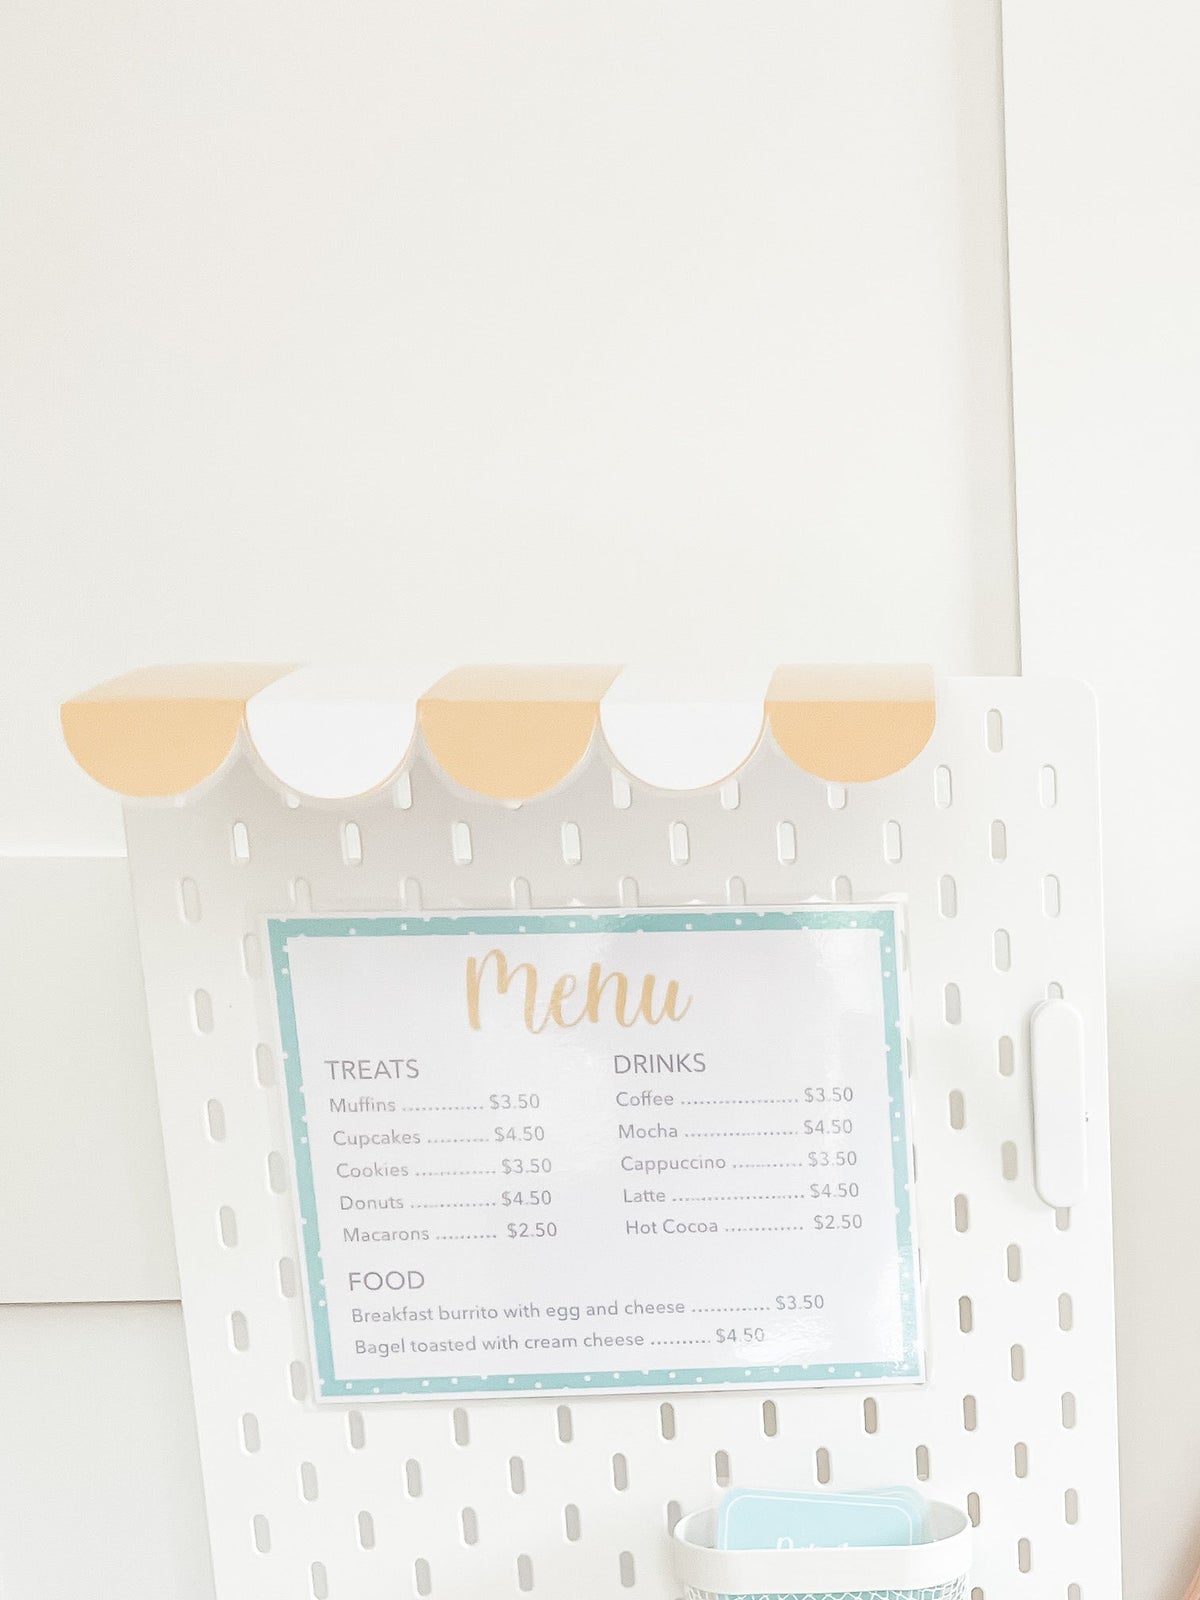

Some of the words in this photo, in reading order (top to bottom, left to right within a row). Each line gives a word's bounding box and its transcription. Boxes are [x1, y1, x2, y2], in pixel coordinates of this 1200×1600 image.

[465, 948, 693, 1034] Menu
[324, 1059, 420, 1080] TREATS
[614, 1053, 707, 1075] DRINKS
[329, 1096, 396, 1113] Muffins
[489, 1094, 540, 1110] $3.50
[616, 1090, 674, 1107] Coffee
[804, 1087, 853, 1103] $3.50
[333, 1129, 421, 1149] Cupcakes
[494, 1126, 545, 1142] $4.50
[618, 1123, 678, 1139] Mocha
[804, 1119, 853, 1135] $4.50
[336, 1162, 409, 1178] Cookies
[501, 1158, 552, 1175] $3.50
[621, 1155, 726, 1174] Cappuccino
[808, 1151, 857, 1167] $3.50
[340, 1195, 404, 1211] Donuts
[501, 1190, 552, 1207] $4.50
[623, 1189, 666, 1204] Latte
[810, 1183, 859, 1199] $4.50
[343, 1228, 430, 1242] Macarons
[507, 1222, 557, 1239] $2.50
[626, 1220, 657, 1235] Hot
[662, 1219, 718, 1234] Cocoa
[814, 1214, 863, 1230] $2.50
[348, 1270, 425, 1291] FOOD
[352, 1306, 433, 1323] Breakfast
[439, 1305, 498, 1321] burrito
[503, 1303, 540, 1319] with
[546, 1305, 580, 1321] egg
[586, 1300, 618, 1316] and
[624, 1300, 686, 1315] cheese
[775, 1294, 825, 1310] $3.50
[355, 1338, 405, 1358] Bagel
[410, 1336, 476, 1353] toasted
[482, 1334, 519, 1350] with
[524, 1336, 577, 1350] cream
[583, 1332, 645, 1347] cheese
[715, 1327, 765, 1343] $4.50
